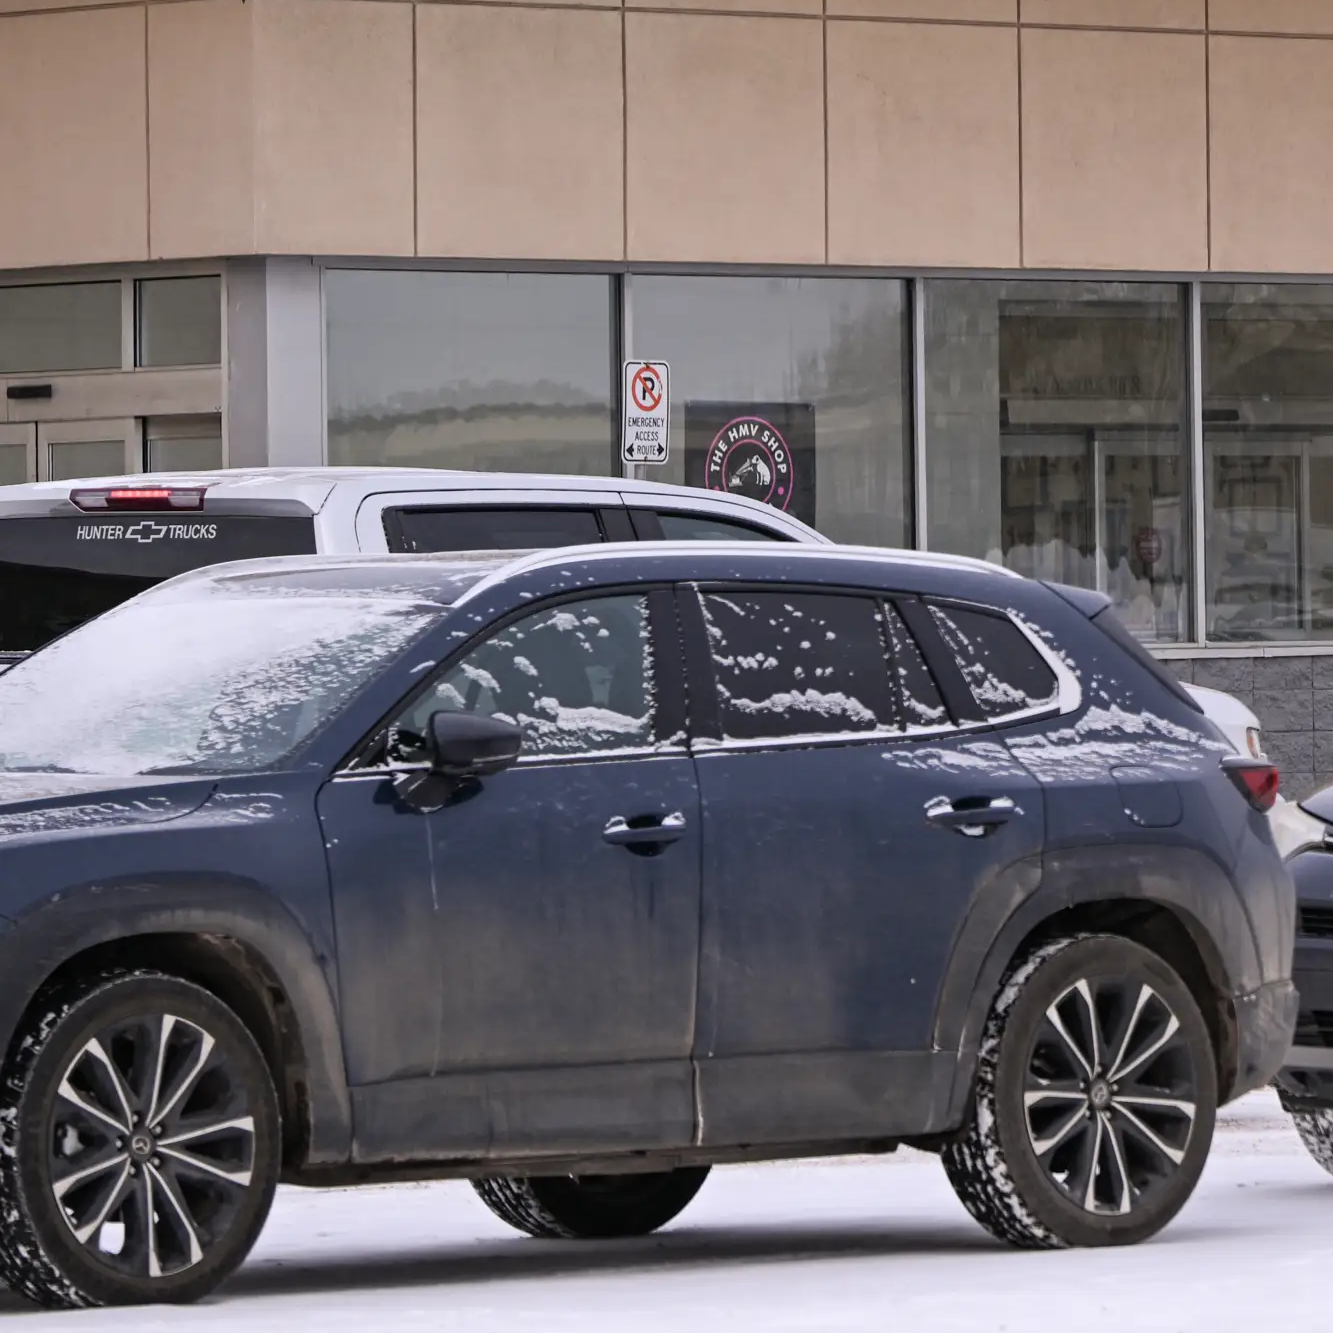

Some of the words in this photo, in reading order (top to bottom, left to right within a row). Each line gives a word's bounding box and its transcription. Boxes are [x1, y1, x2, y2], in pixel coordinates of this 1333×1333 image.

[628, 416, 665, 428] EMERGENCY
[634, 431, 659, 442] ACCESS
[636, 445, 657, 456] ROUTE
[710, 440, 728, 473] THE
[728, 423, 759, 443] HMV
[761, 430, 787, 474] SHOP
[76, 525, 124, 540] HUNTER
[168, 524, 218, 539] TRUCKS
